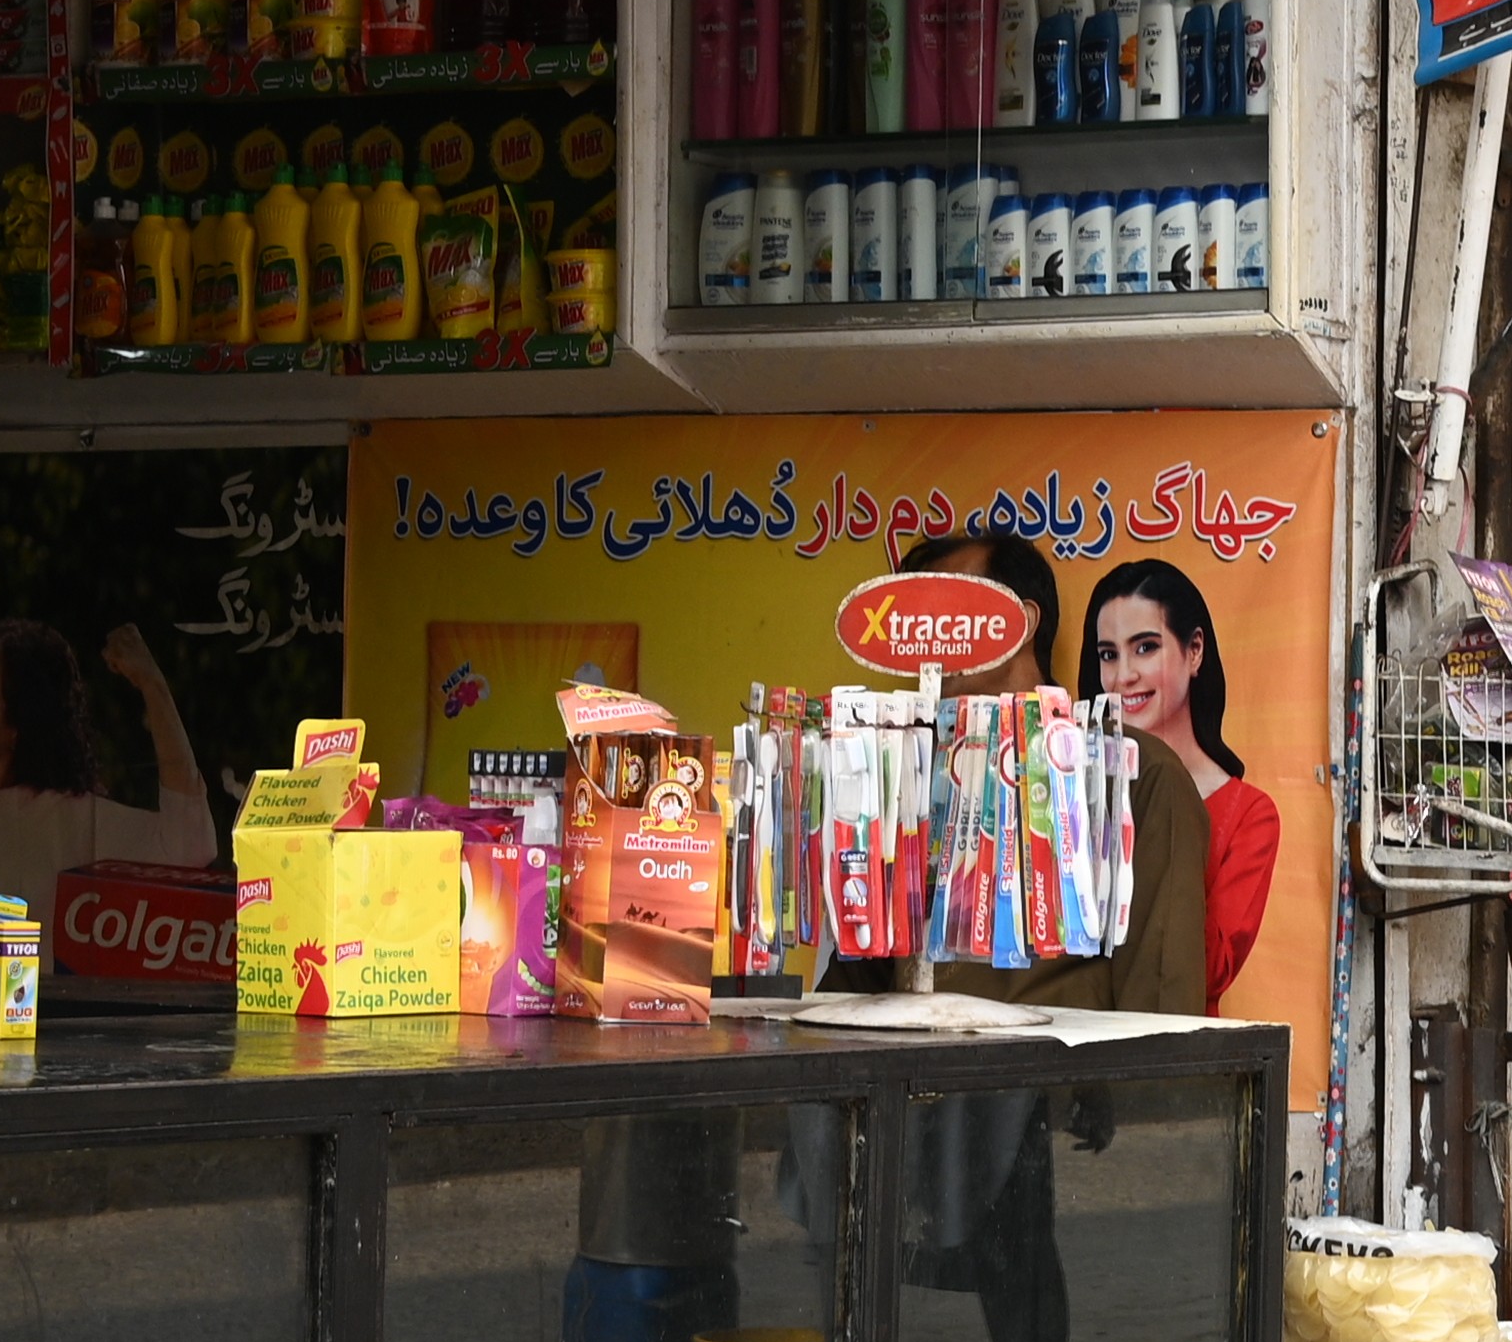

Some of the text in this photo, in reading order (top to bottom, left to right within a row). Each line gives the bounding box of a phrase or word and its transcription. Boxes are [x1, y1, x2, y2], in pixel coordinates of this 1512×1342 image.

[474, 38, 536, 82] 3X
[553, 469, 607, 539] کا
[795, 469, 880, 558] دار
[1125, 459, 1298, 561] جھاگ
[886, 490, 955, 572] دم
[859, 595, 1006, 645] Xtracare
[889, 640, 972, 656] Tooth Brush
[308, 731, 354, 759] Dashi
[260, 777, 322, 789] Flavored
[253, 795, 307, 808] Chicken
[245, 811, 337, 827] Zaiqa Powder
[625, 834, 710, 852] Metromilan
[639, 859, 692, 880] Oudh
[6, 943, 38, 956] TYFON
[361, 965, 428, 985] Chicken
[336, 989, 453, 1013] Zaiqa Powder
